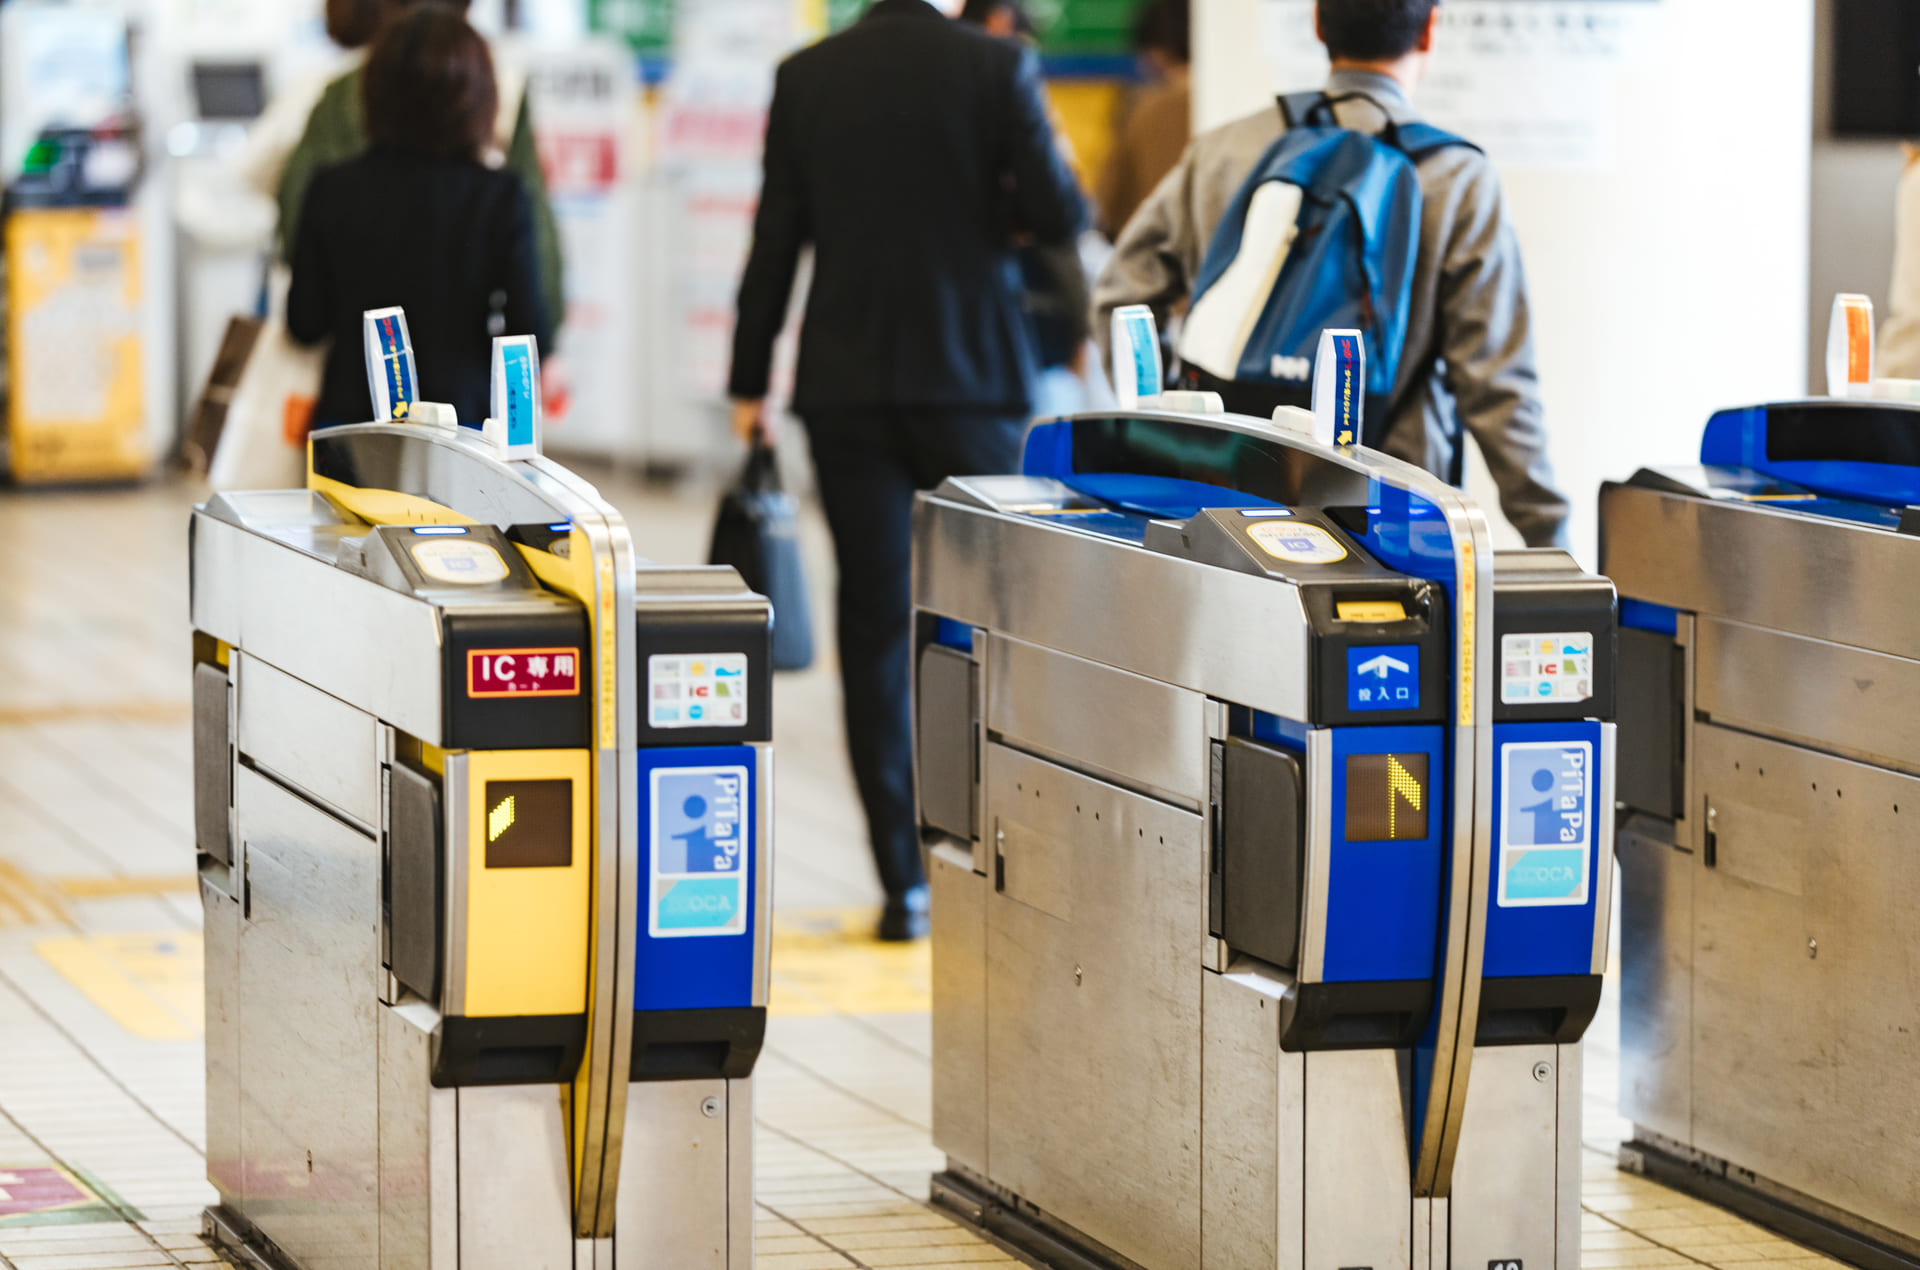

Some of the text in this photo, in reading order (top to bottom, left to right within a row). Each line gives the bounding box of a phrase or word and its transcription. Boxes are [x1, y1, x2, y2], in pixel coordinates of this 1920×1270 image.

[482, 655, 575, 681] IC 専用
[1358, 686, 1410, 702] 投入口
[713, 776, 740, 871] PiTaPa
[1560, 751, 1585, 842] PiTaPa
